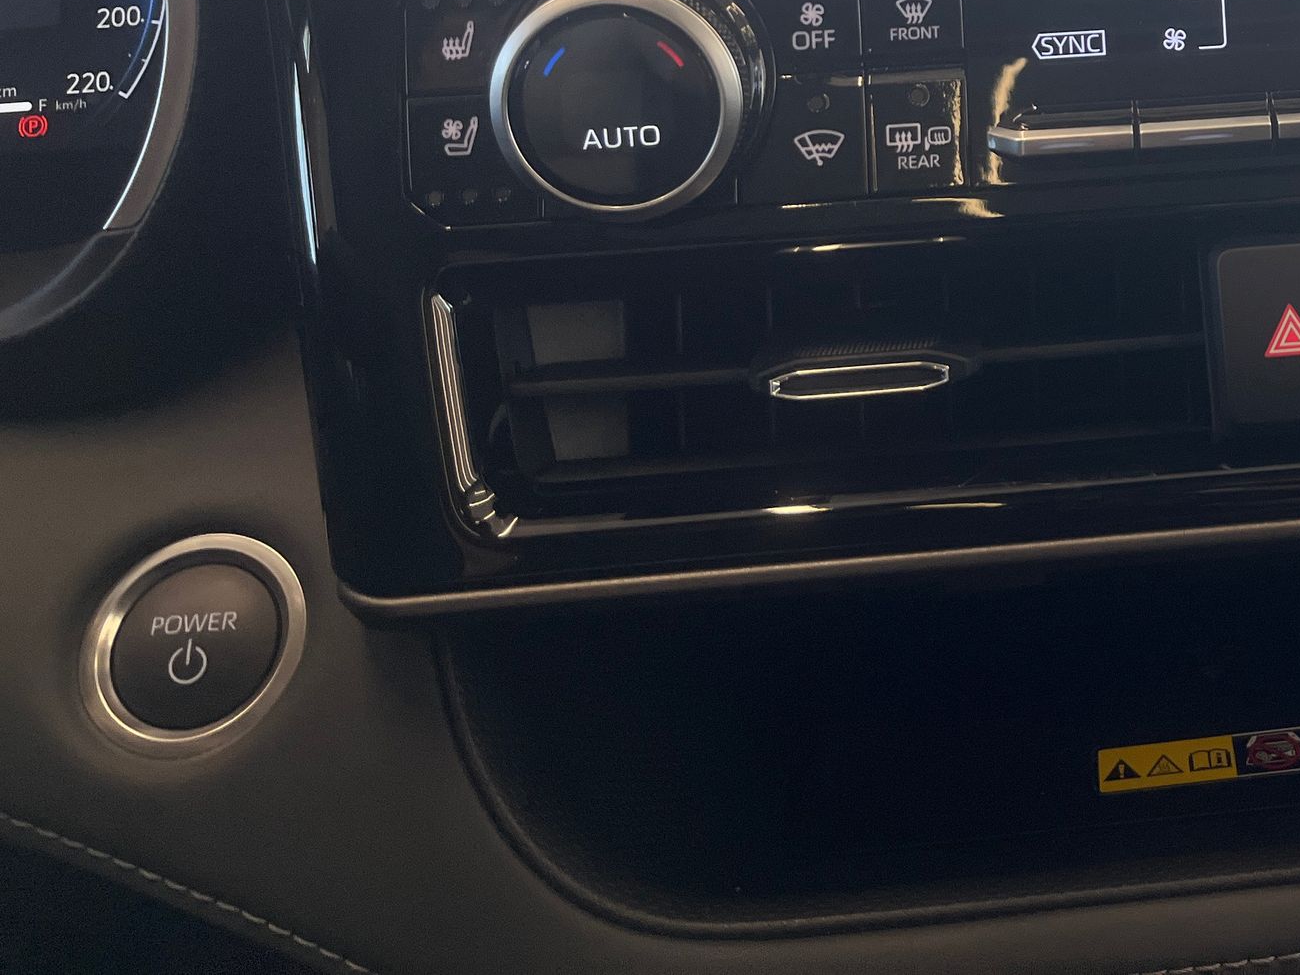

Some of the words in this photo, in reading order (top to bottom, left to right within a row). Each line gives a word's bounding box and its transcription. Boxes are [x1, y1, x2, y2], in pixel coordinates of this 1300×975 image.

[97, 6, 141, 29] 200
[792, 29, 836, 51] OFF
[890, 25, 941, 42] FRONT
[1040, 34, 1101, 57] SYNC
[66, 71, 110, 95] 220
[39, 98, 48, 112] F
[55, 98, 87, 113] km/h
[582, 124, 661, 152] AUTO
[897, 153, 941, 171] REAR
[150, 611, 237, 636] POWER
